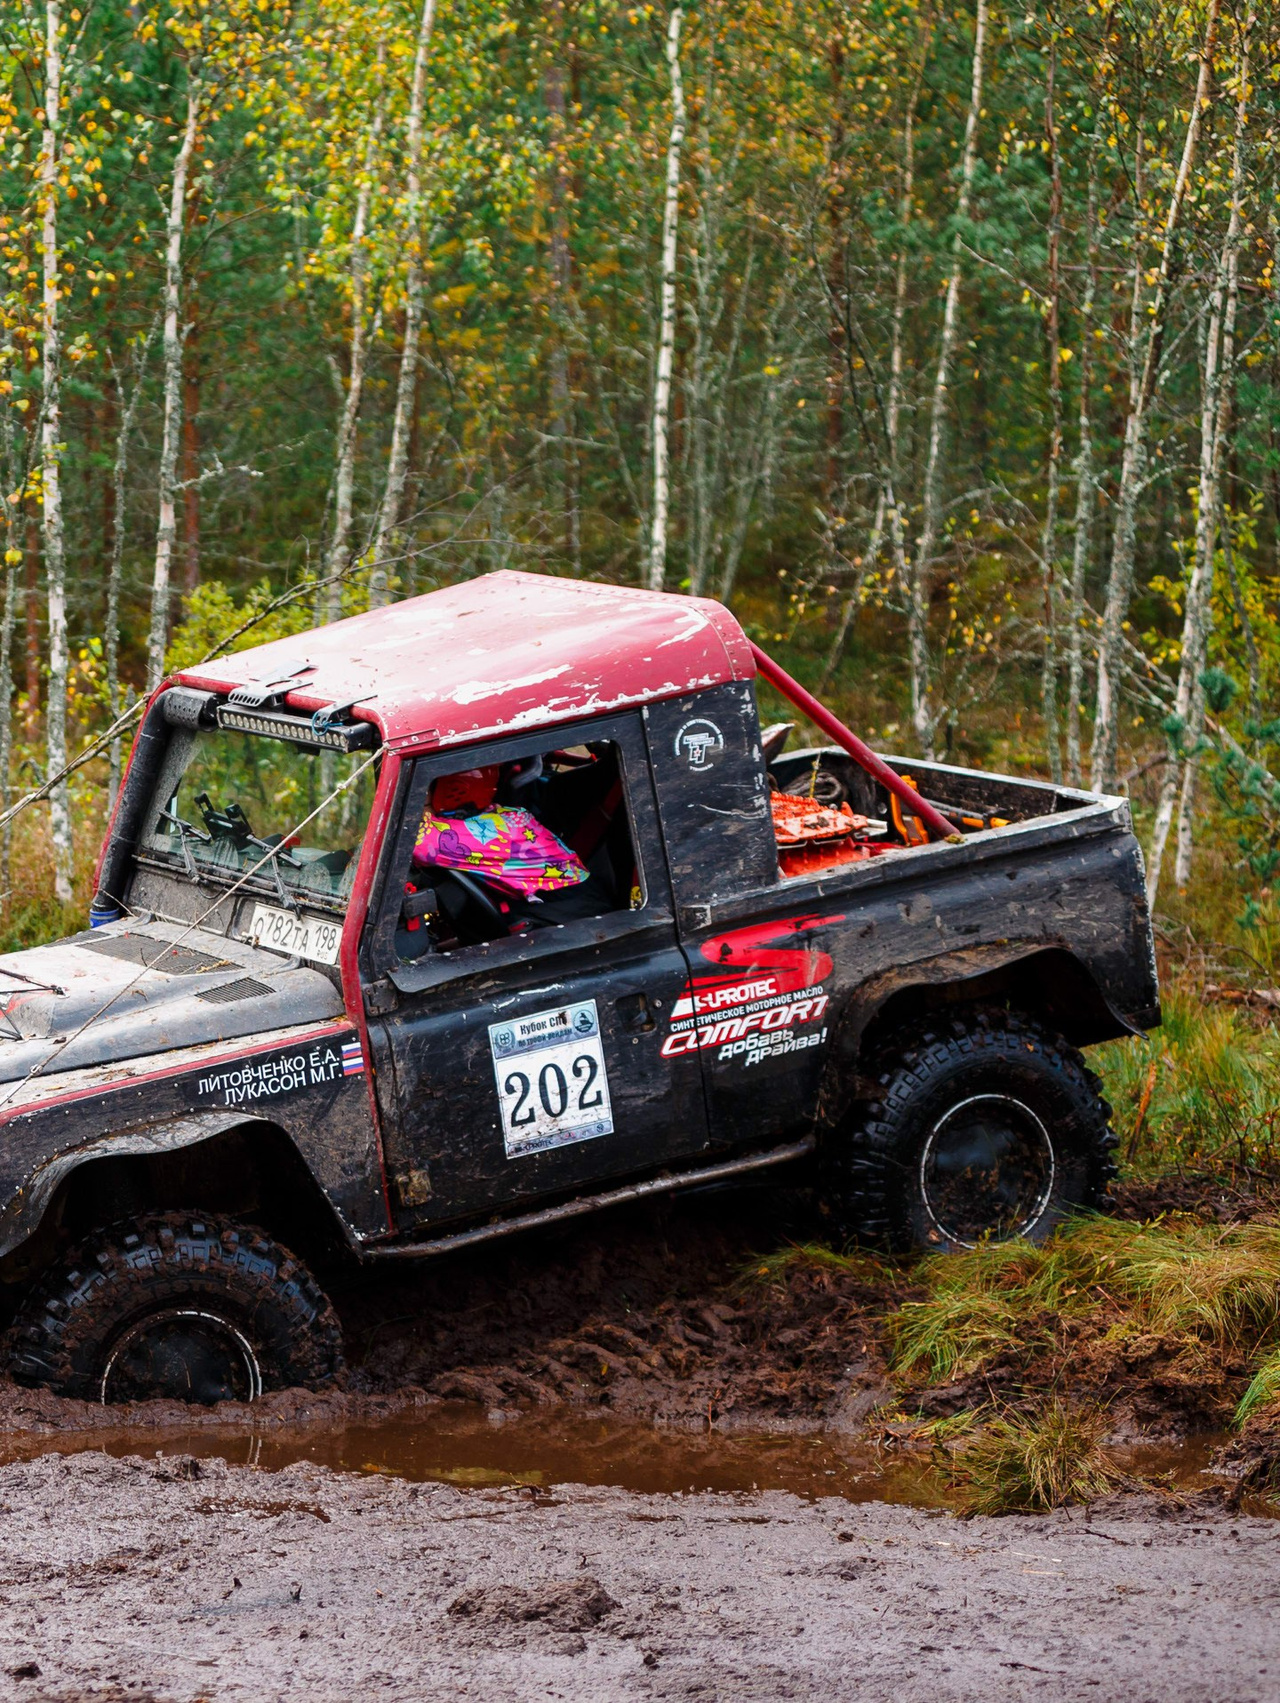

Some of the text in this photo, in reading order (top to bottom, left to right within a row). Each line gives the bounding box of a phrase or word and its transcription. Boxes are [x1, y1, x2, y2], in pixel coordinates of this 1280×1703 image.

[315, 925, 337, 951] 198
[520, 1021, 548, 1036] Кубок
[661, 995, 830, 1056] COMFORT
[670, 985, 824, 1032] СИНТЕТИЧЕСКОЕ МОТОРНОЕ МАСЛО
[198, 1049, 341, 1095] ЛИТОВЧЕНКО Е.А.
[224, 1062, 343, 1106] ЛУКАСОН М.Г.
[504, 1054, 604, 1128] 202
